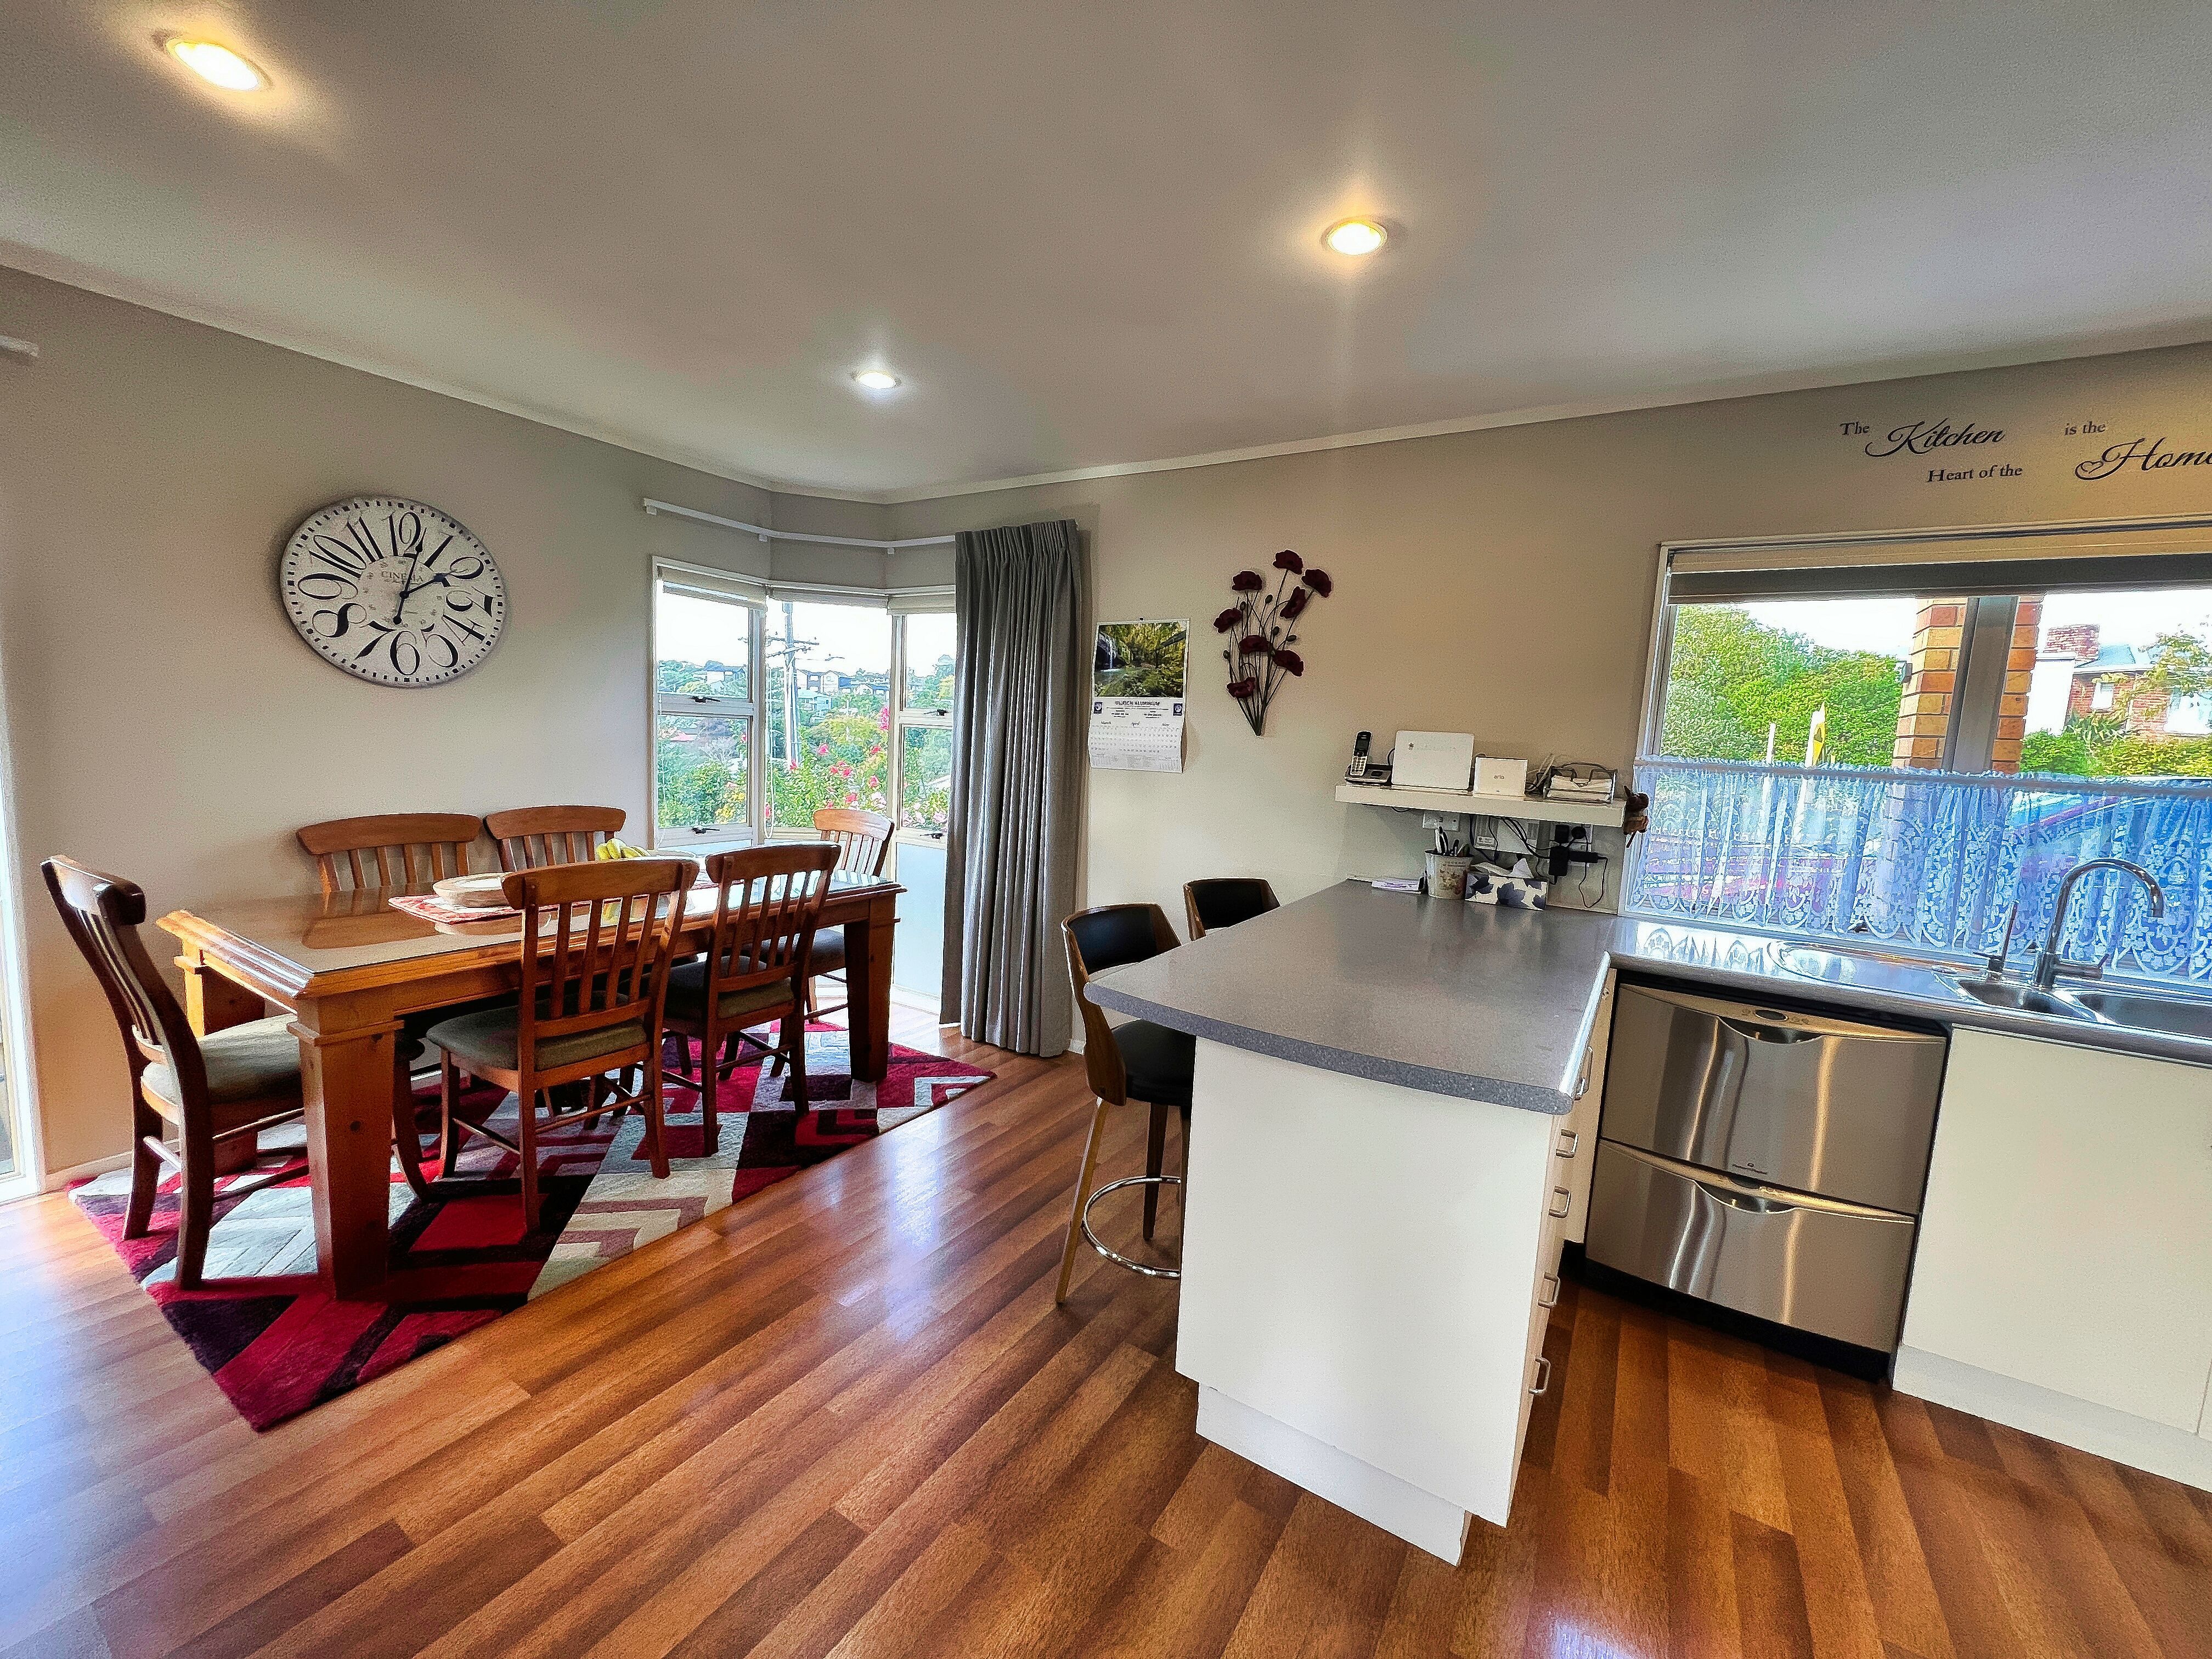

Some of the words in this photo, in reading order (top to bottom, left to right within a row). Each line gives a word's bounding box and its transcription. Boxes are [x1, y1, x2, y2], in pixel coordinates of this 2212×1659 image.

[1840, 421, 1870, 436] The
[1865, 417, 2005, 458] Kitchen
[2065, 422, 2077, 436] is
[2083, 421, 2106, 434] the
[1928, 469, 1974, 483] Heart
[1978, 465, 1998, 479] of
[2000, 464, 2023, 477] the
[341, 512, 385, 565] 11
[381, 510, 421, 558] 12
[422, 532, 454, 571] 1
[309, 534, 367, 579] 10
[435, 556, 484, 588] 2
[297, 573, 358, 600] 9
[445, 586, 494, 618] 3
[312, 602, 368, 639] 8
[355, 620, 397, 661] 7
[442, 609, 488, 646] 4
[390, 631, 420, 676] 6
[420, 623, 459, 668] 5
